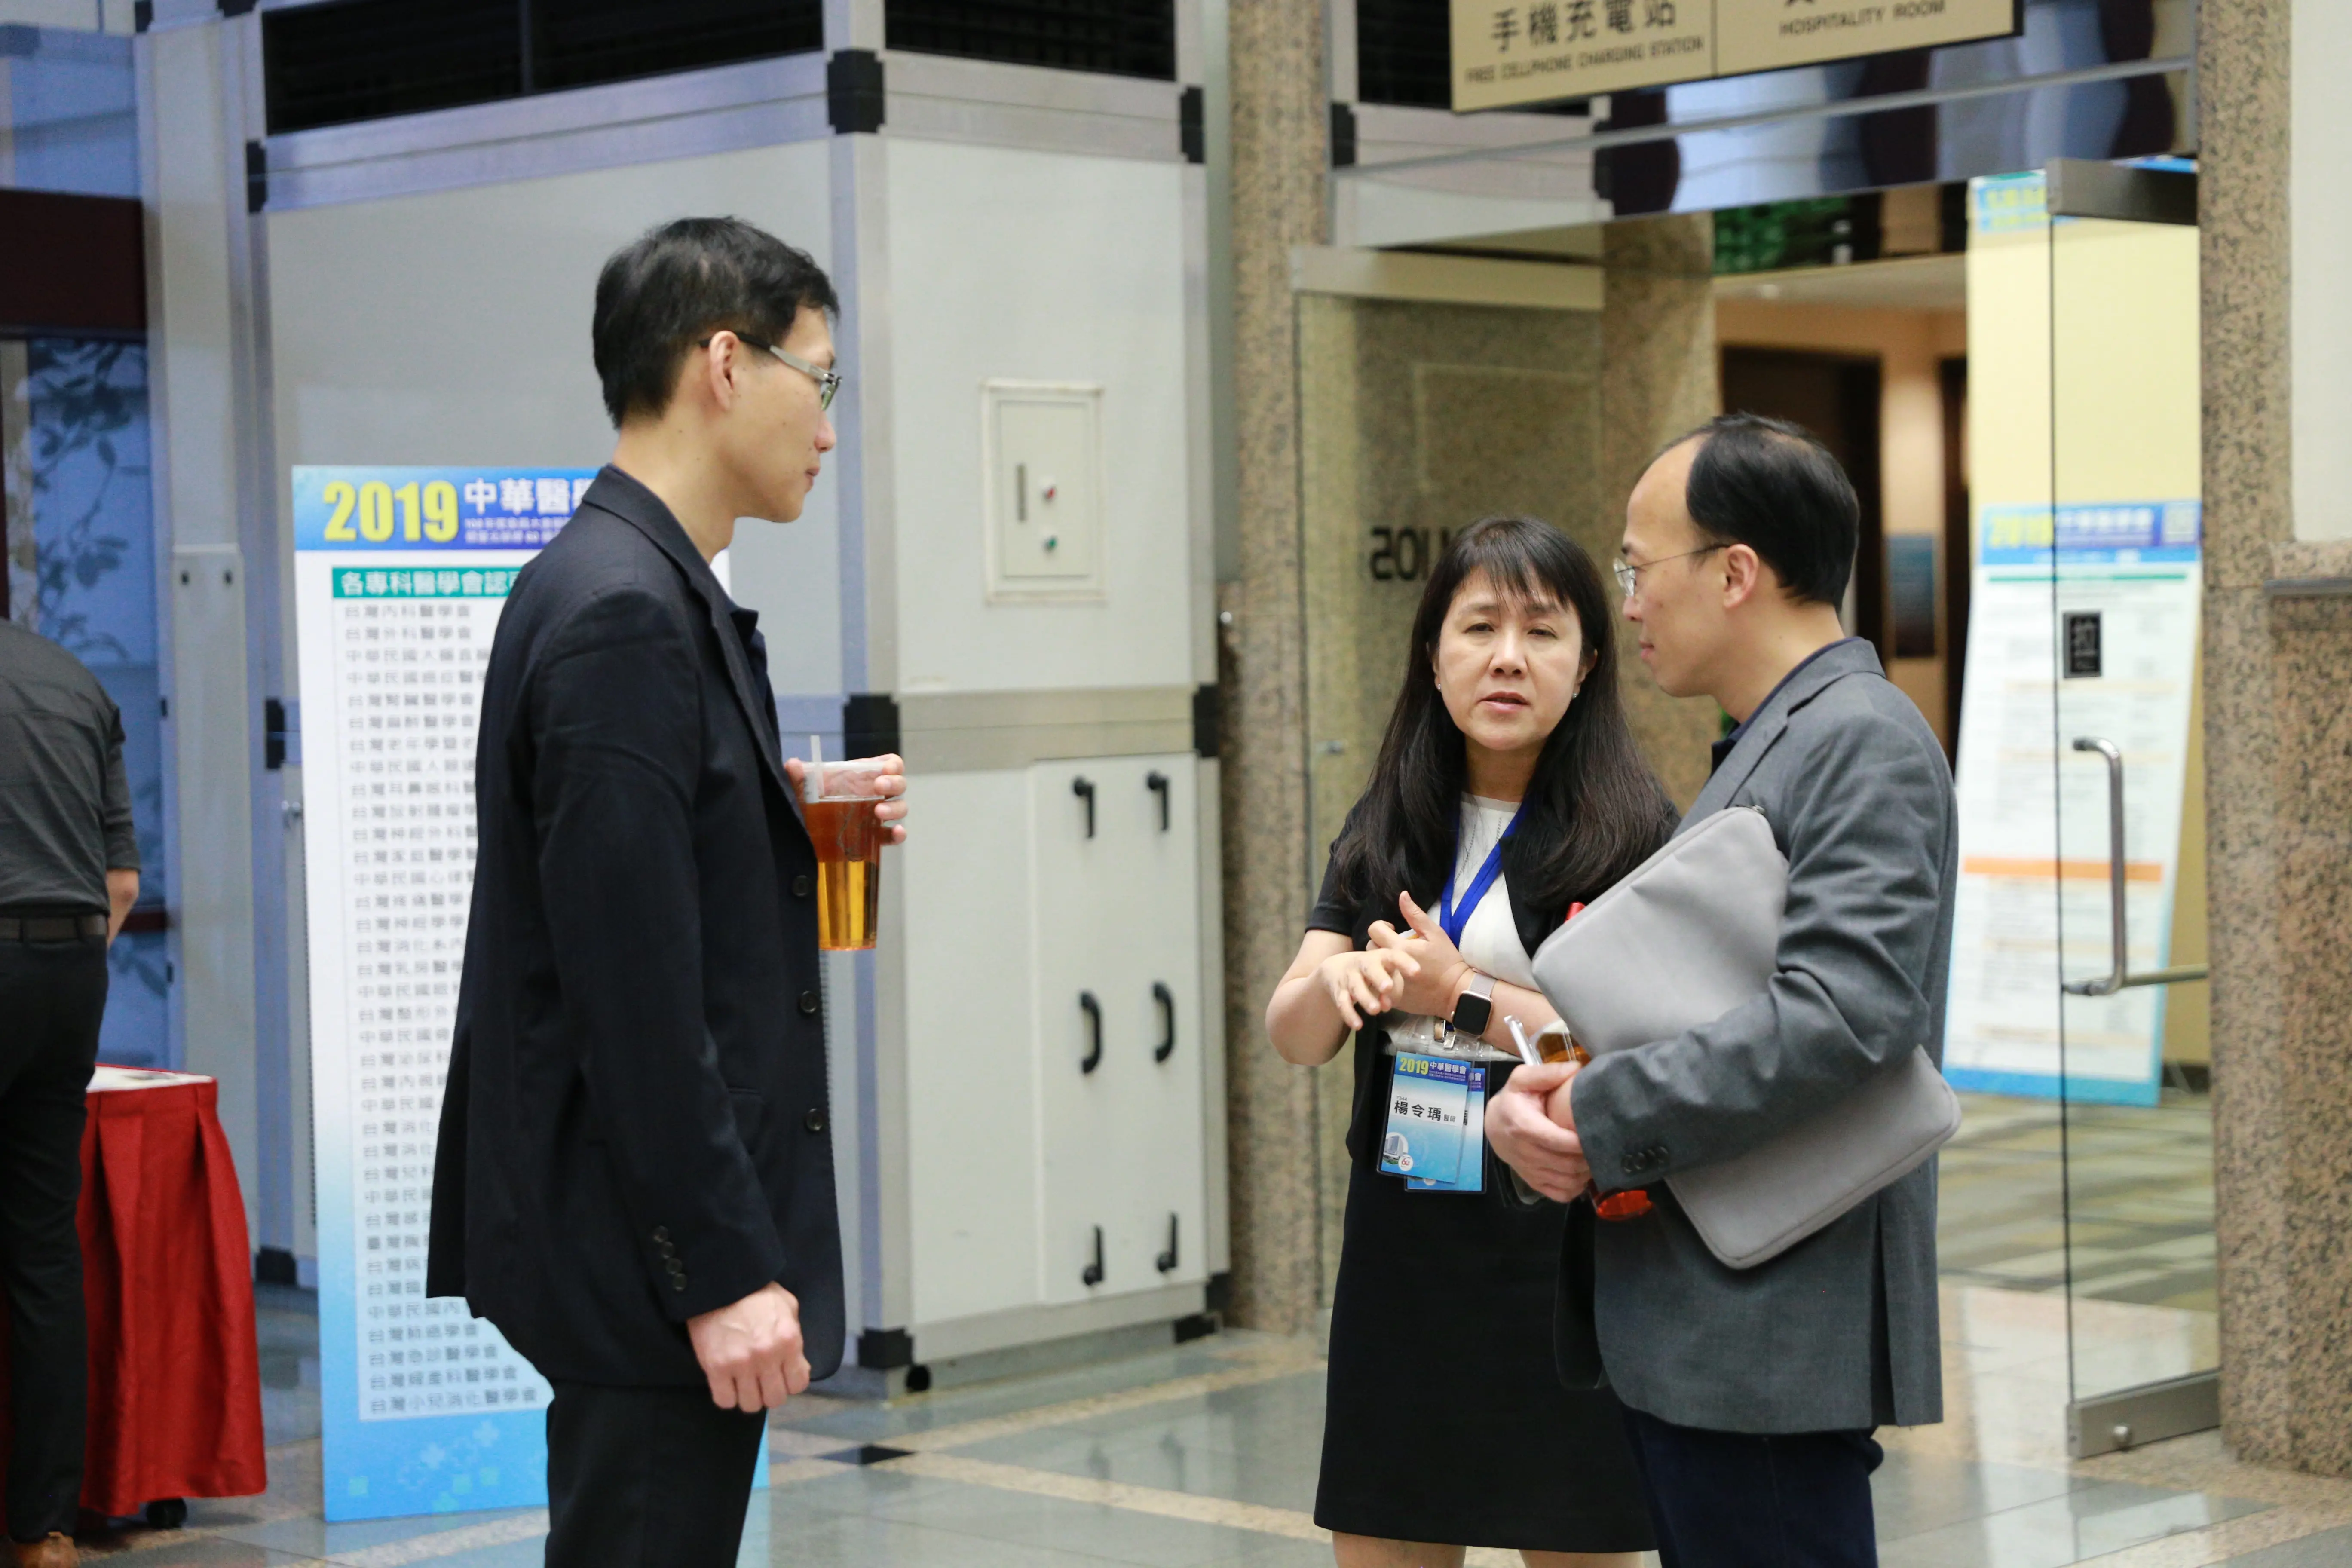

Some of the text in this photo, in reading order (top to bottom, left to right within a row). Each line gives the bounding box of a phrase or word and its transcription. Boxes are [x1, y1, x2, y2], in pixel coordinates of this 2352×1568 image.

[1491, 0, 1677, 52] 手機充電站
[1779, 0, 1945, 37] HOSPITALITY ROOM
[1465, 36, 1703, 84] FREE CELLPHONE CHARGING STATION
[323, 480, 458, 543] 2019
[1399, 1057, 1429, 1075] 2019
[1430, 1061, 1467, 1074] 中華醫學會
[1444, 1114, 1456, 1122] 醫師
